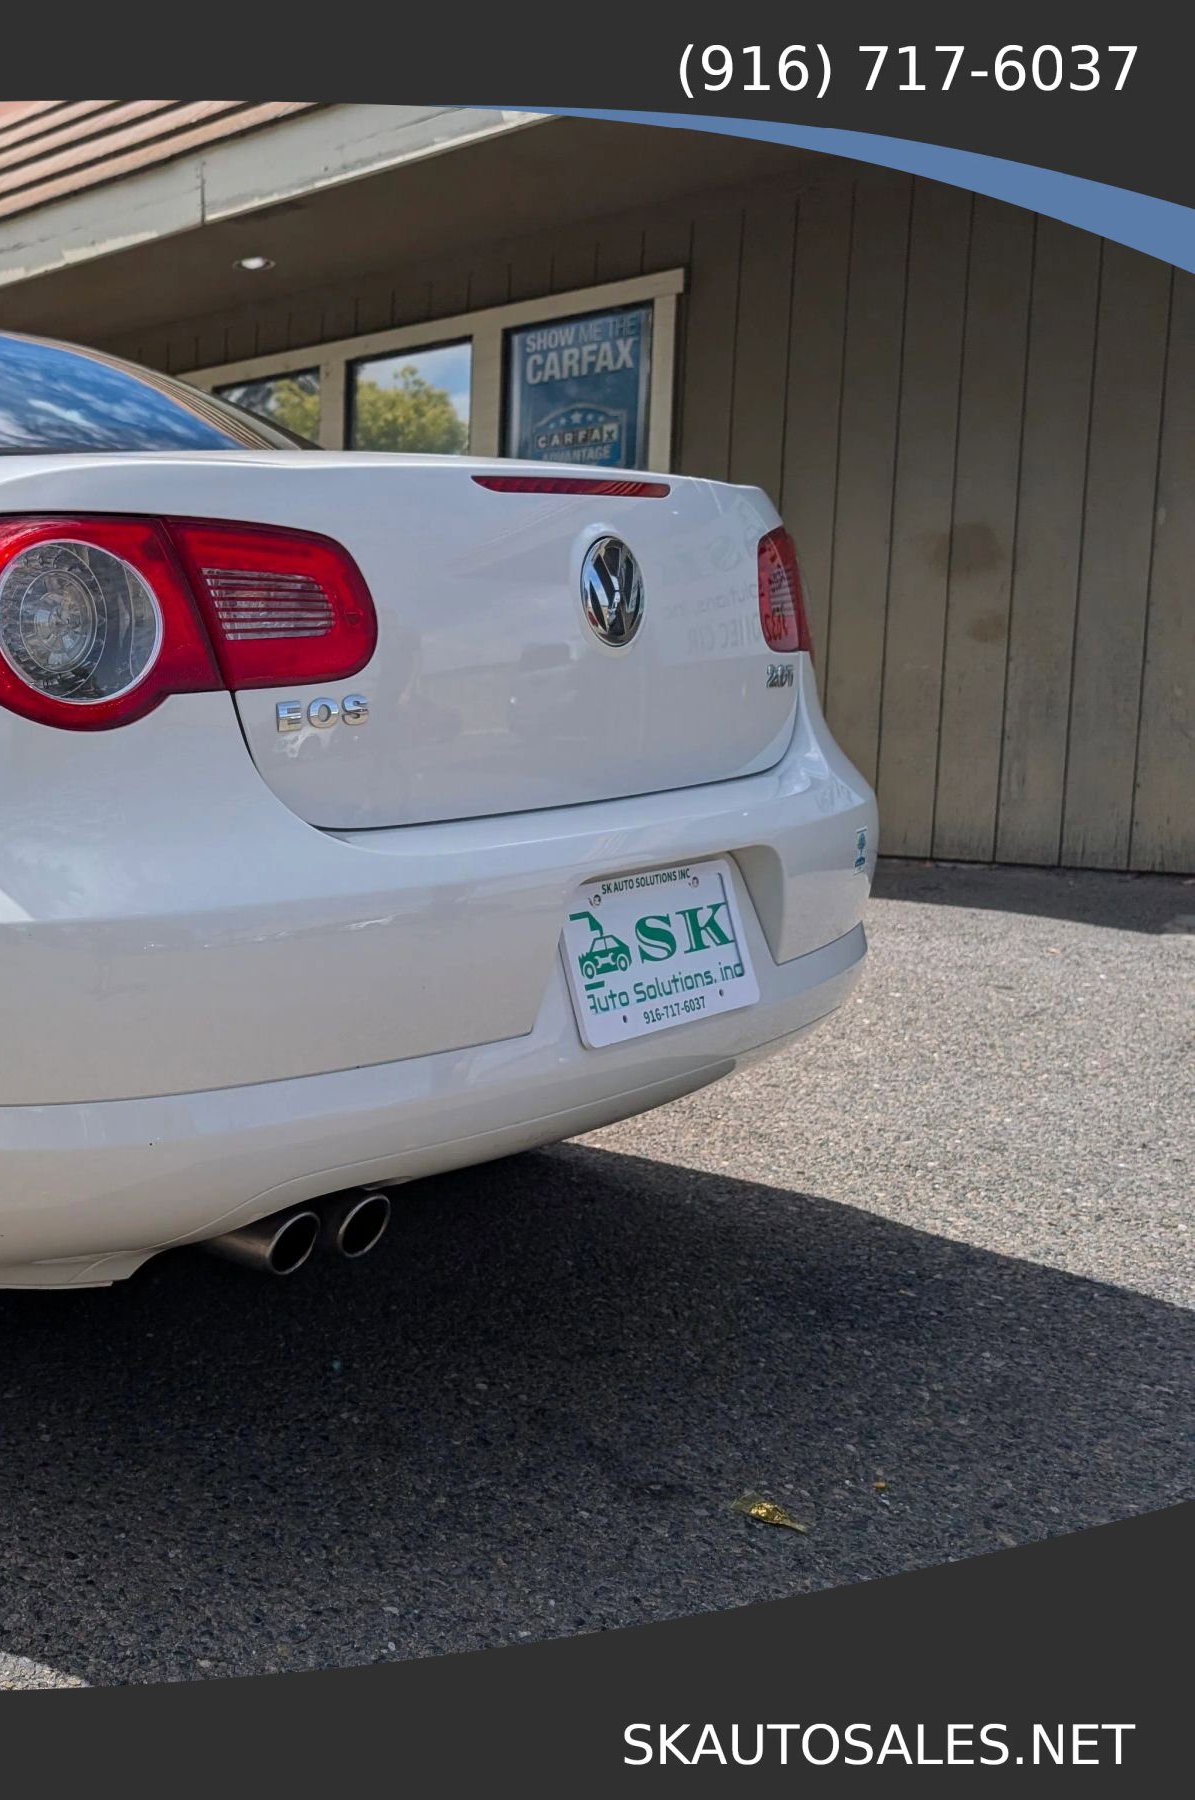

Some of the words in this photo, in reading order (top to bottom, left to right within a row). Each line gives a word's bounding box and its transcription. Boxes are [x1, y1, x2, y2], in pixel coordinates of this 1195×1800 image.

[527, 328, 574, 352] SHOW
[579, 321, 602, 343] ME
[607, 316, 637, 337] THE
[526, 338, 633, 384] CARFAX
[537, 427, 616, 448] CARFAX
[276, 694, 369, 732] EOS
[601, 883, 613, 895] SK
[613, 878, 635, 893] AUTO
[635, 872, 677, 888] SOLUTIONS
[678, 868, 691, 880] INC
[635, 902, 735, 963] SK
[644, 997, 705, 1024] 916-717-6037
